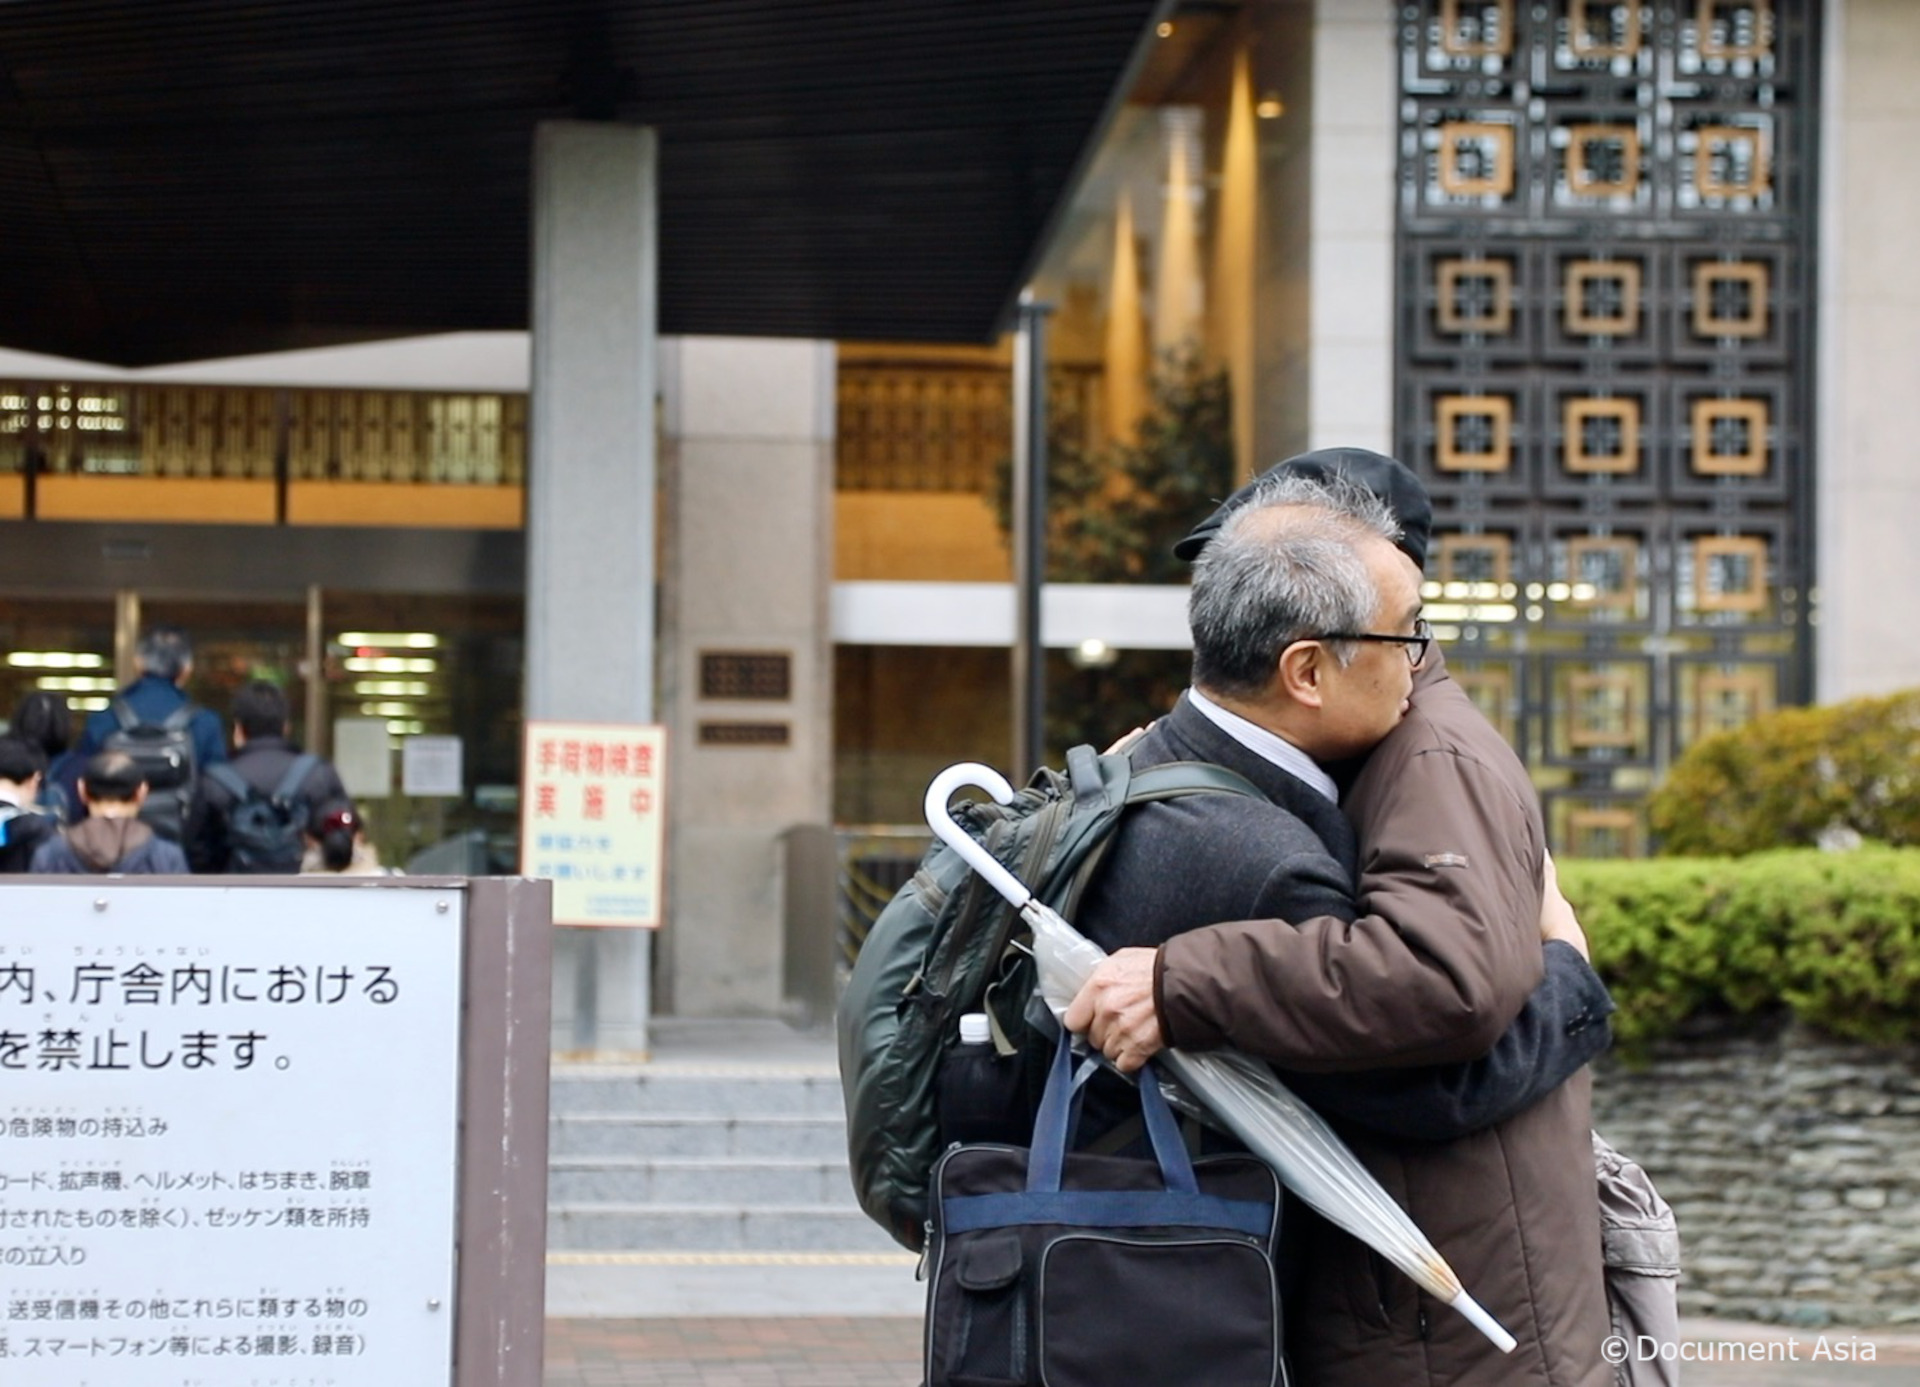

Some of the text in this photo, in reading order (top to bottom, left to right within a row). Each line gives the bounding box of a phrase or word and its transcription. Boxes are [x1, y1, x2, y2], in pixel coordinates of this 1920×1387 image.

[0, 962, 399, 1005] 内、庁舎内における
[0, 1029, 290, 1071] を禁止します。
[0, 1246, 87, 1267] の立入り
